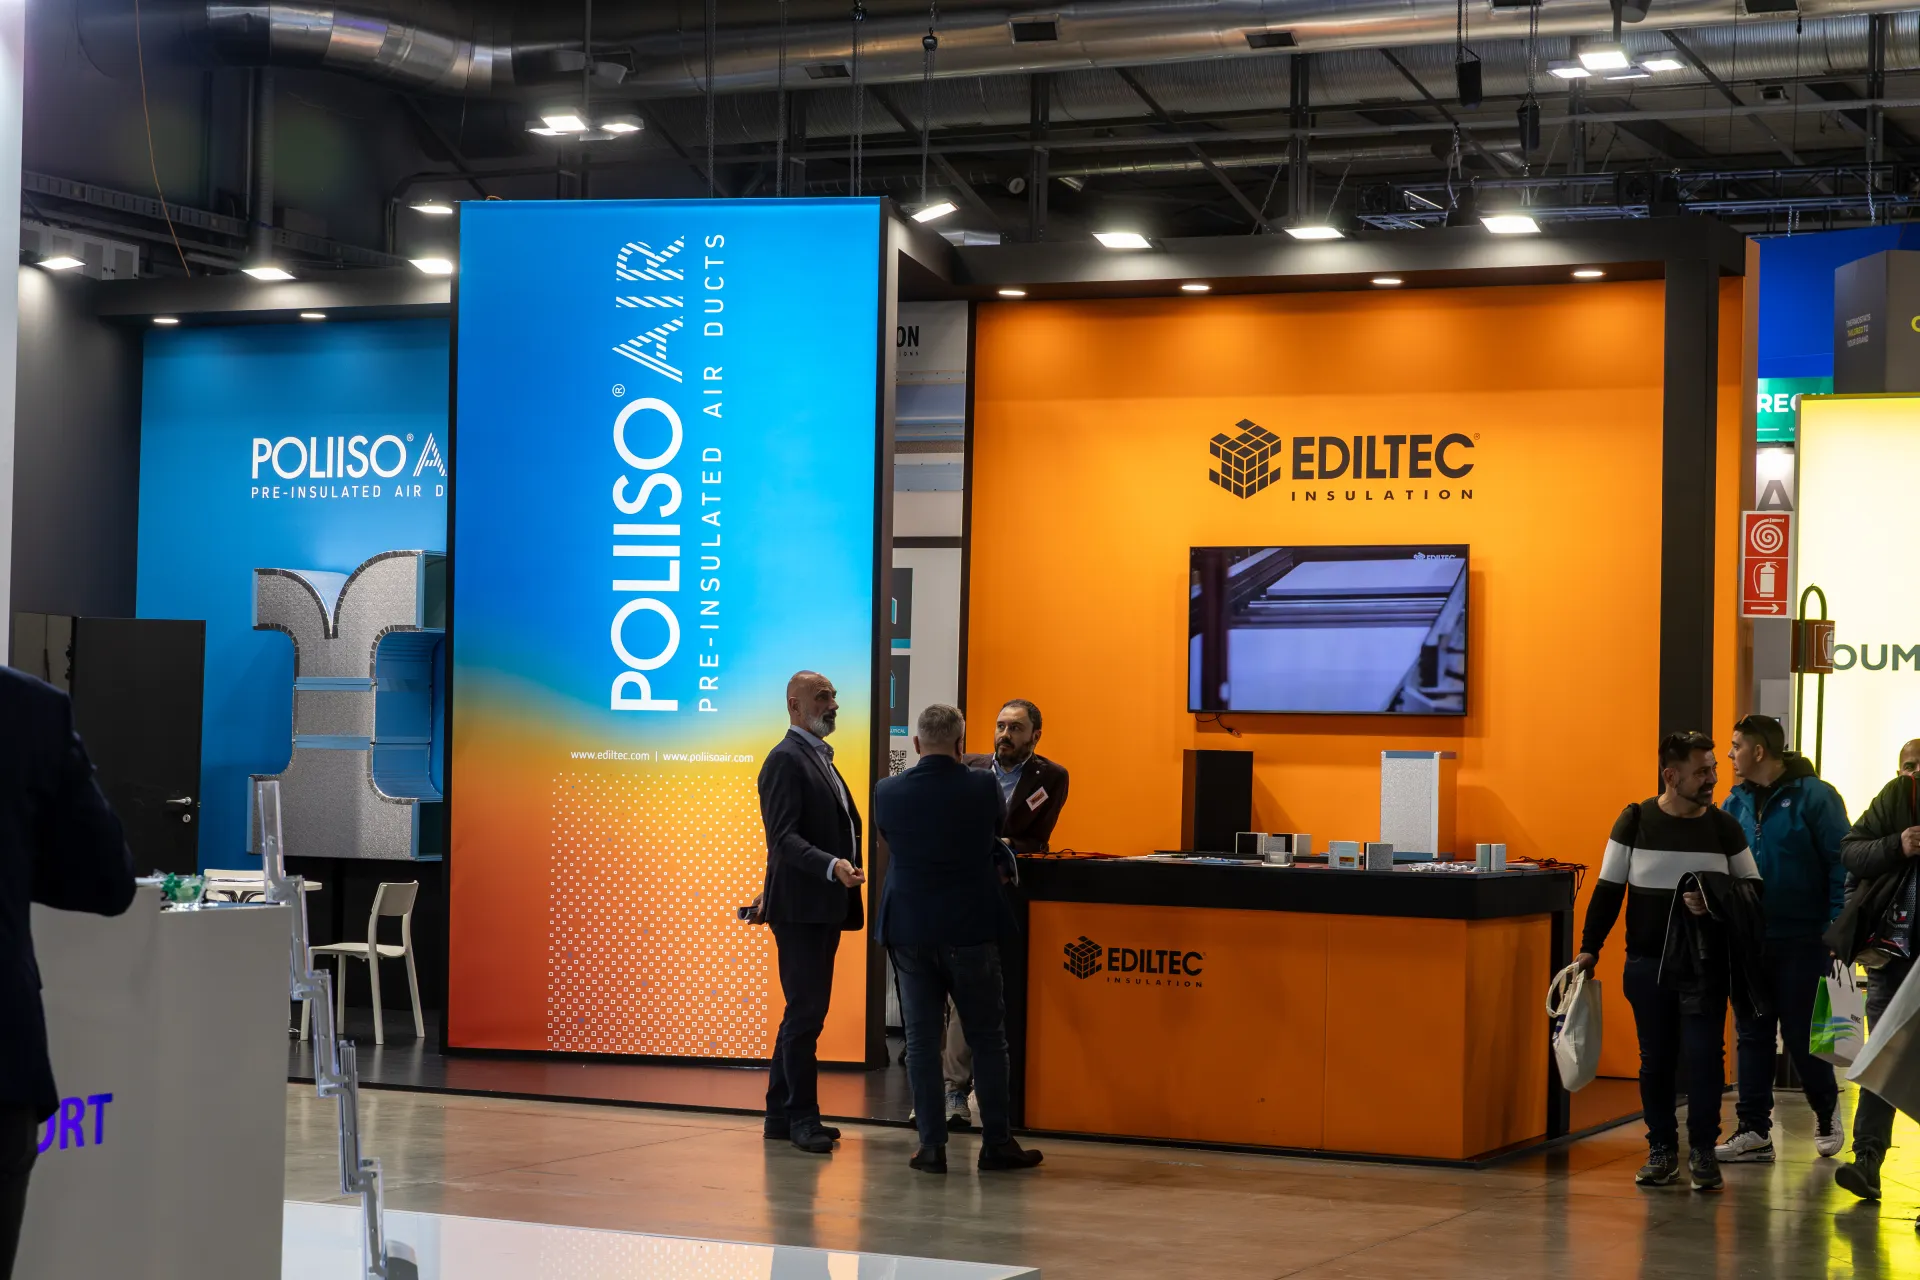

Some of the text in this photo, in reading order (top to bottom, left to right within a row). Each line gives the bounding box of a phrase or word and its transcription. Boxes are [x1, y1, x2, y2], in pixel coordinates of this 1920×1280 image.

[611, 235, 685, 384] AIR
[698, 234, 725, 713] PRE-INSULATED AIR DUCTS
[251, 485, 382, 499] PRE-INSULATED
[394, 484, 422, 498] AIR
[1291, 489, 1473, 502] INSULATION
[570, 750, 754, 763] www.ediltec.com www.poliisoair.com
[1106, 976, 1203, 988] INSULATION
